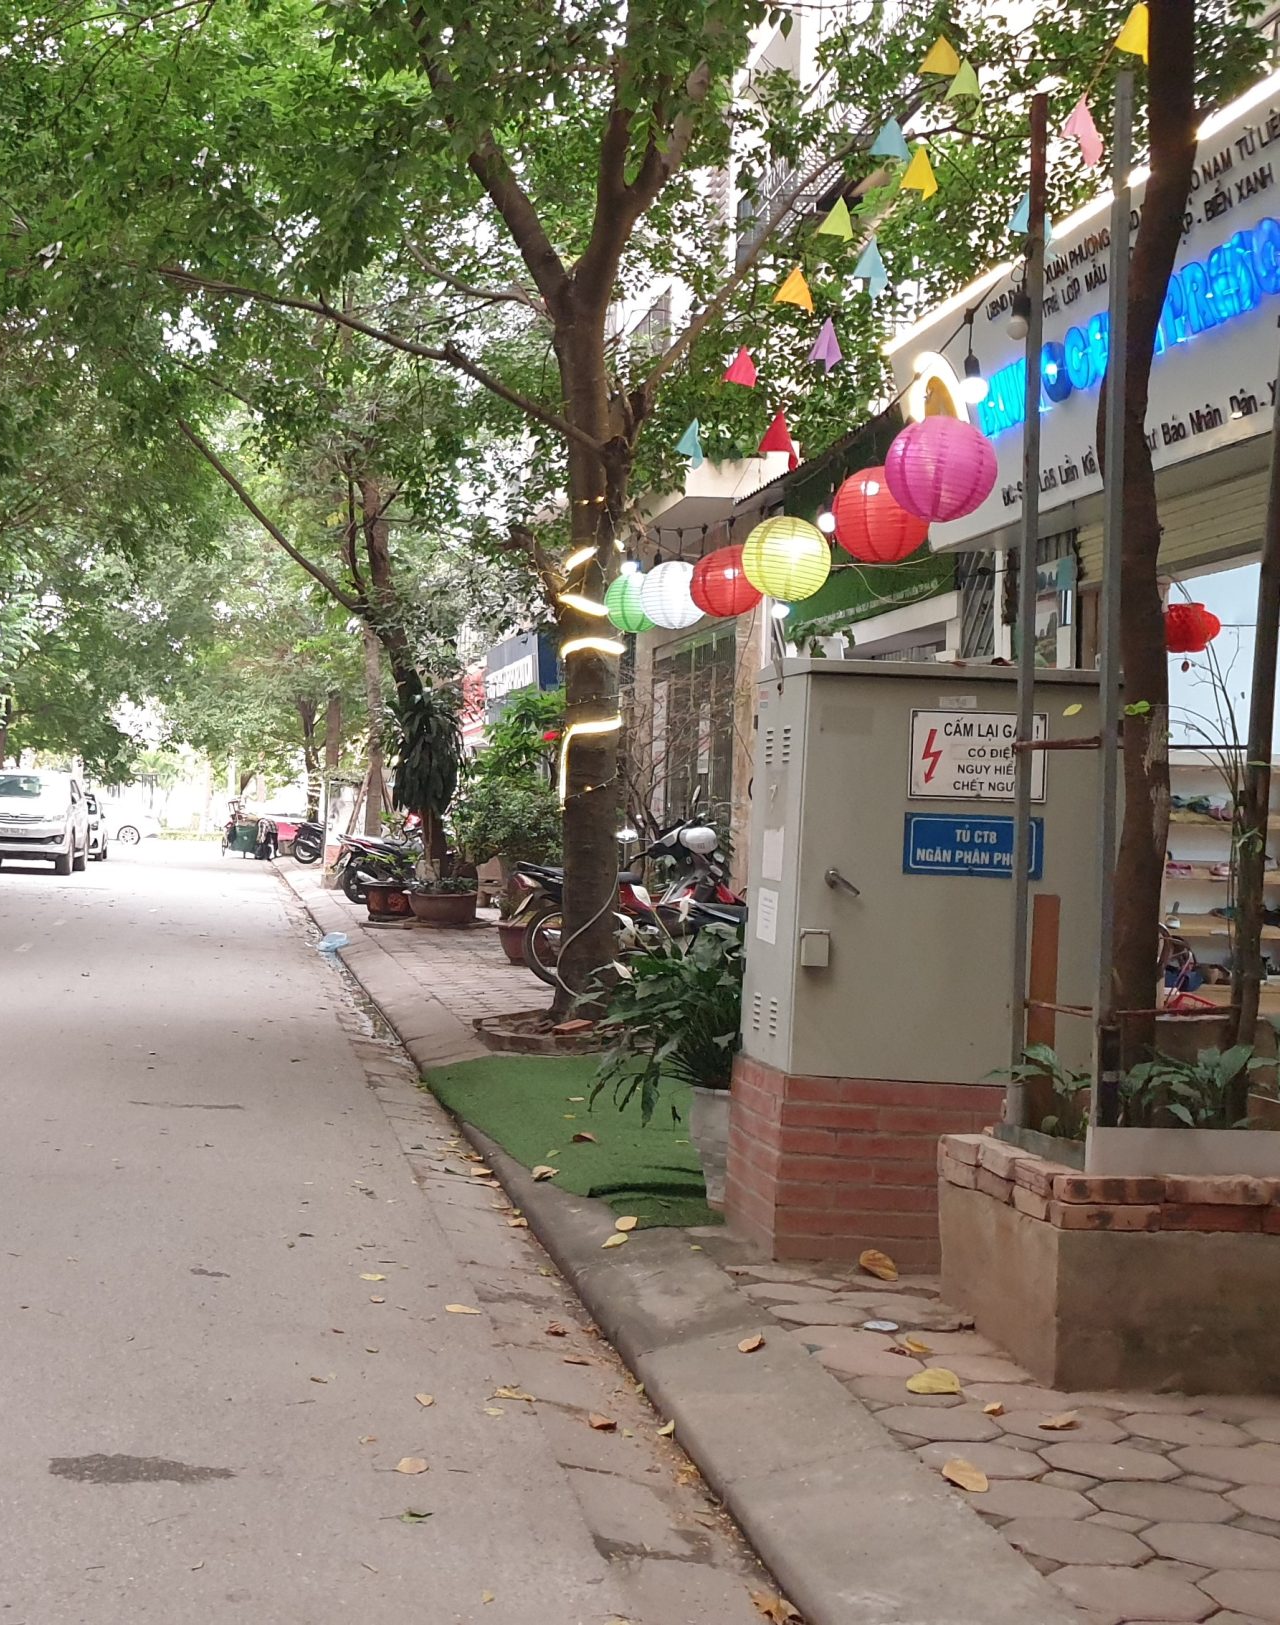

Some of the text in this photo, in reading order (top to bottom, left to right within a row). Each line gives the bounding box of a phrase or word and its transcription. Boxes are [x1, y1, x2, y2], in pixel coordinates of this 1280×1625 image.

[1201, 147, 1233, 184] NAM
[1234, 125, 1256, 160] TỪ
[1234, 162, 1275, 204] XANH
[1161, 413, 1186, 446] Báo
[1189, 403, 1223, 435] Nhân
[943, 717, 974, 738] CẤM
[977, 723, 999, 742] LẠI
[967, 746, 986, 758] CÓ
[957, 759, 1016, 776] NGUY HIỂ
[952, 777, 985, 792] CHẾT
[955, 824, 970, 843] TỦ
[916, 846, 951, 863] NGĂN
[955, 848, 990, 865] PHÂN
